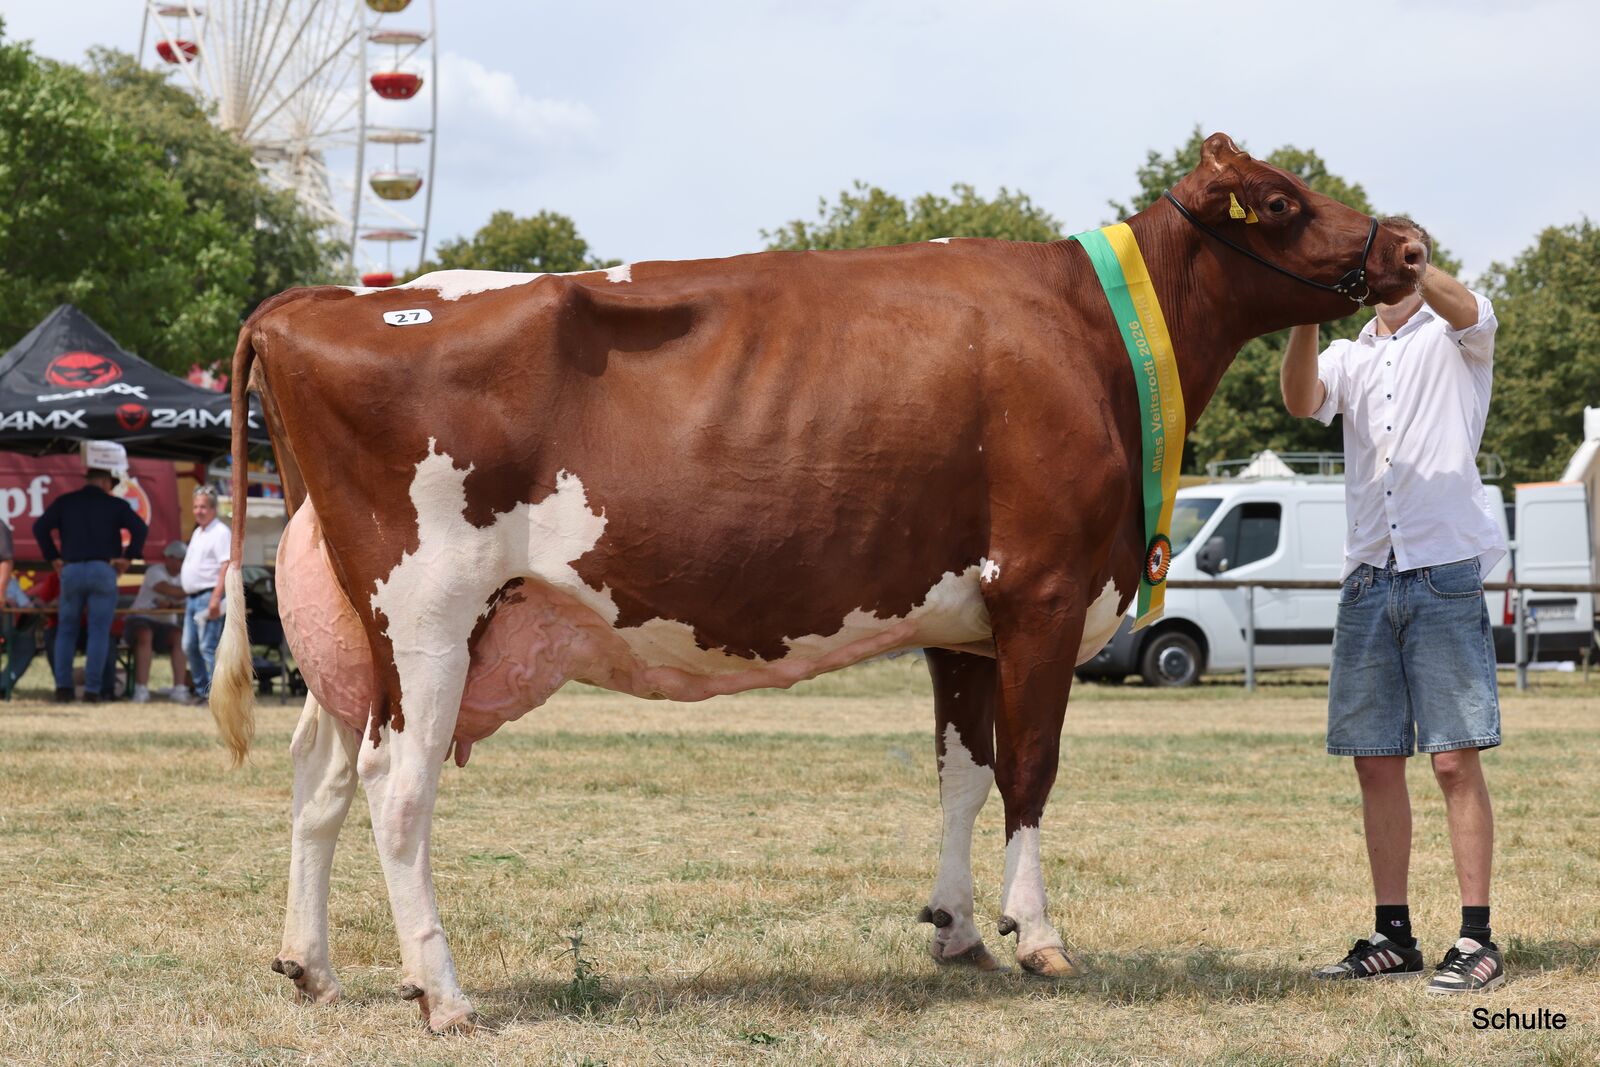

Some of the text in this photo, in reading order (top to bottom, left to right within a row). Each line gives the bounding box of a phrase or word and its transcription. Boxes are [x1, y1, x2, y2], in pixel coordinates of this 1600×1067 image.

[394, 312, 421, 323] 27
[1127, 320, 1164, 473] Miss Veitsrodt 2026
[0, 409, 88, 430] 4MX
